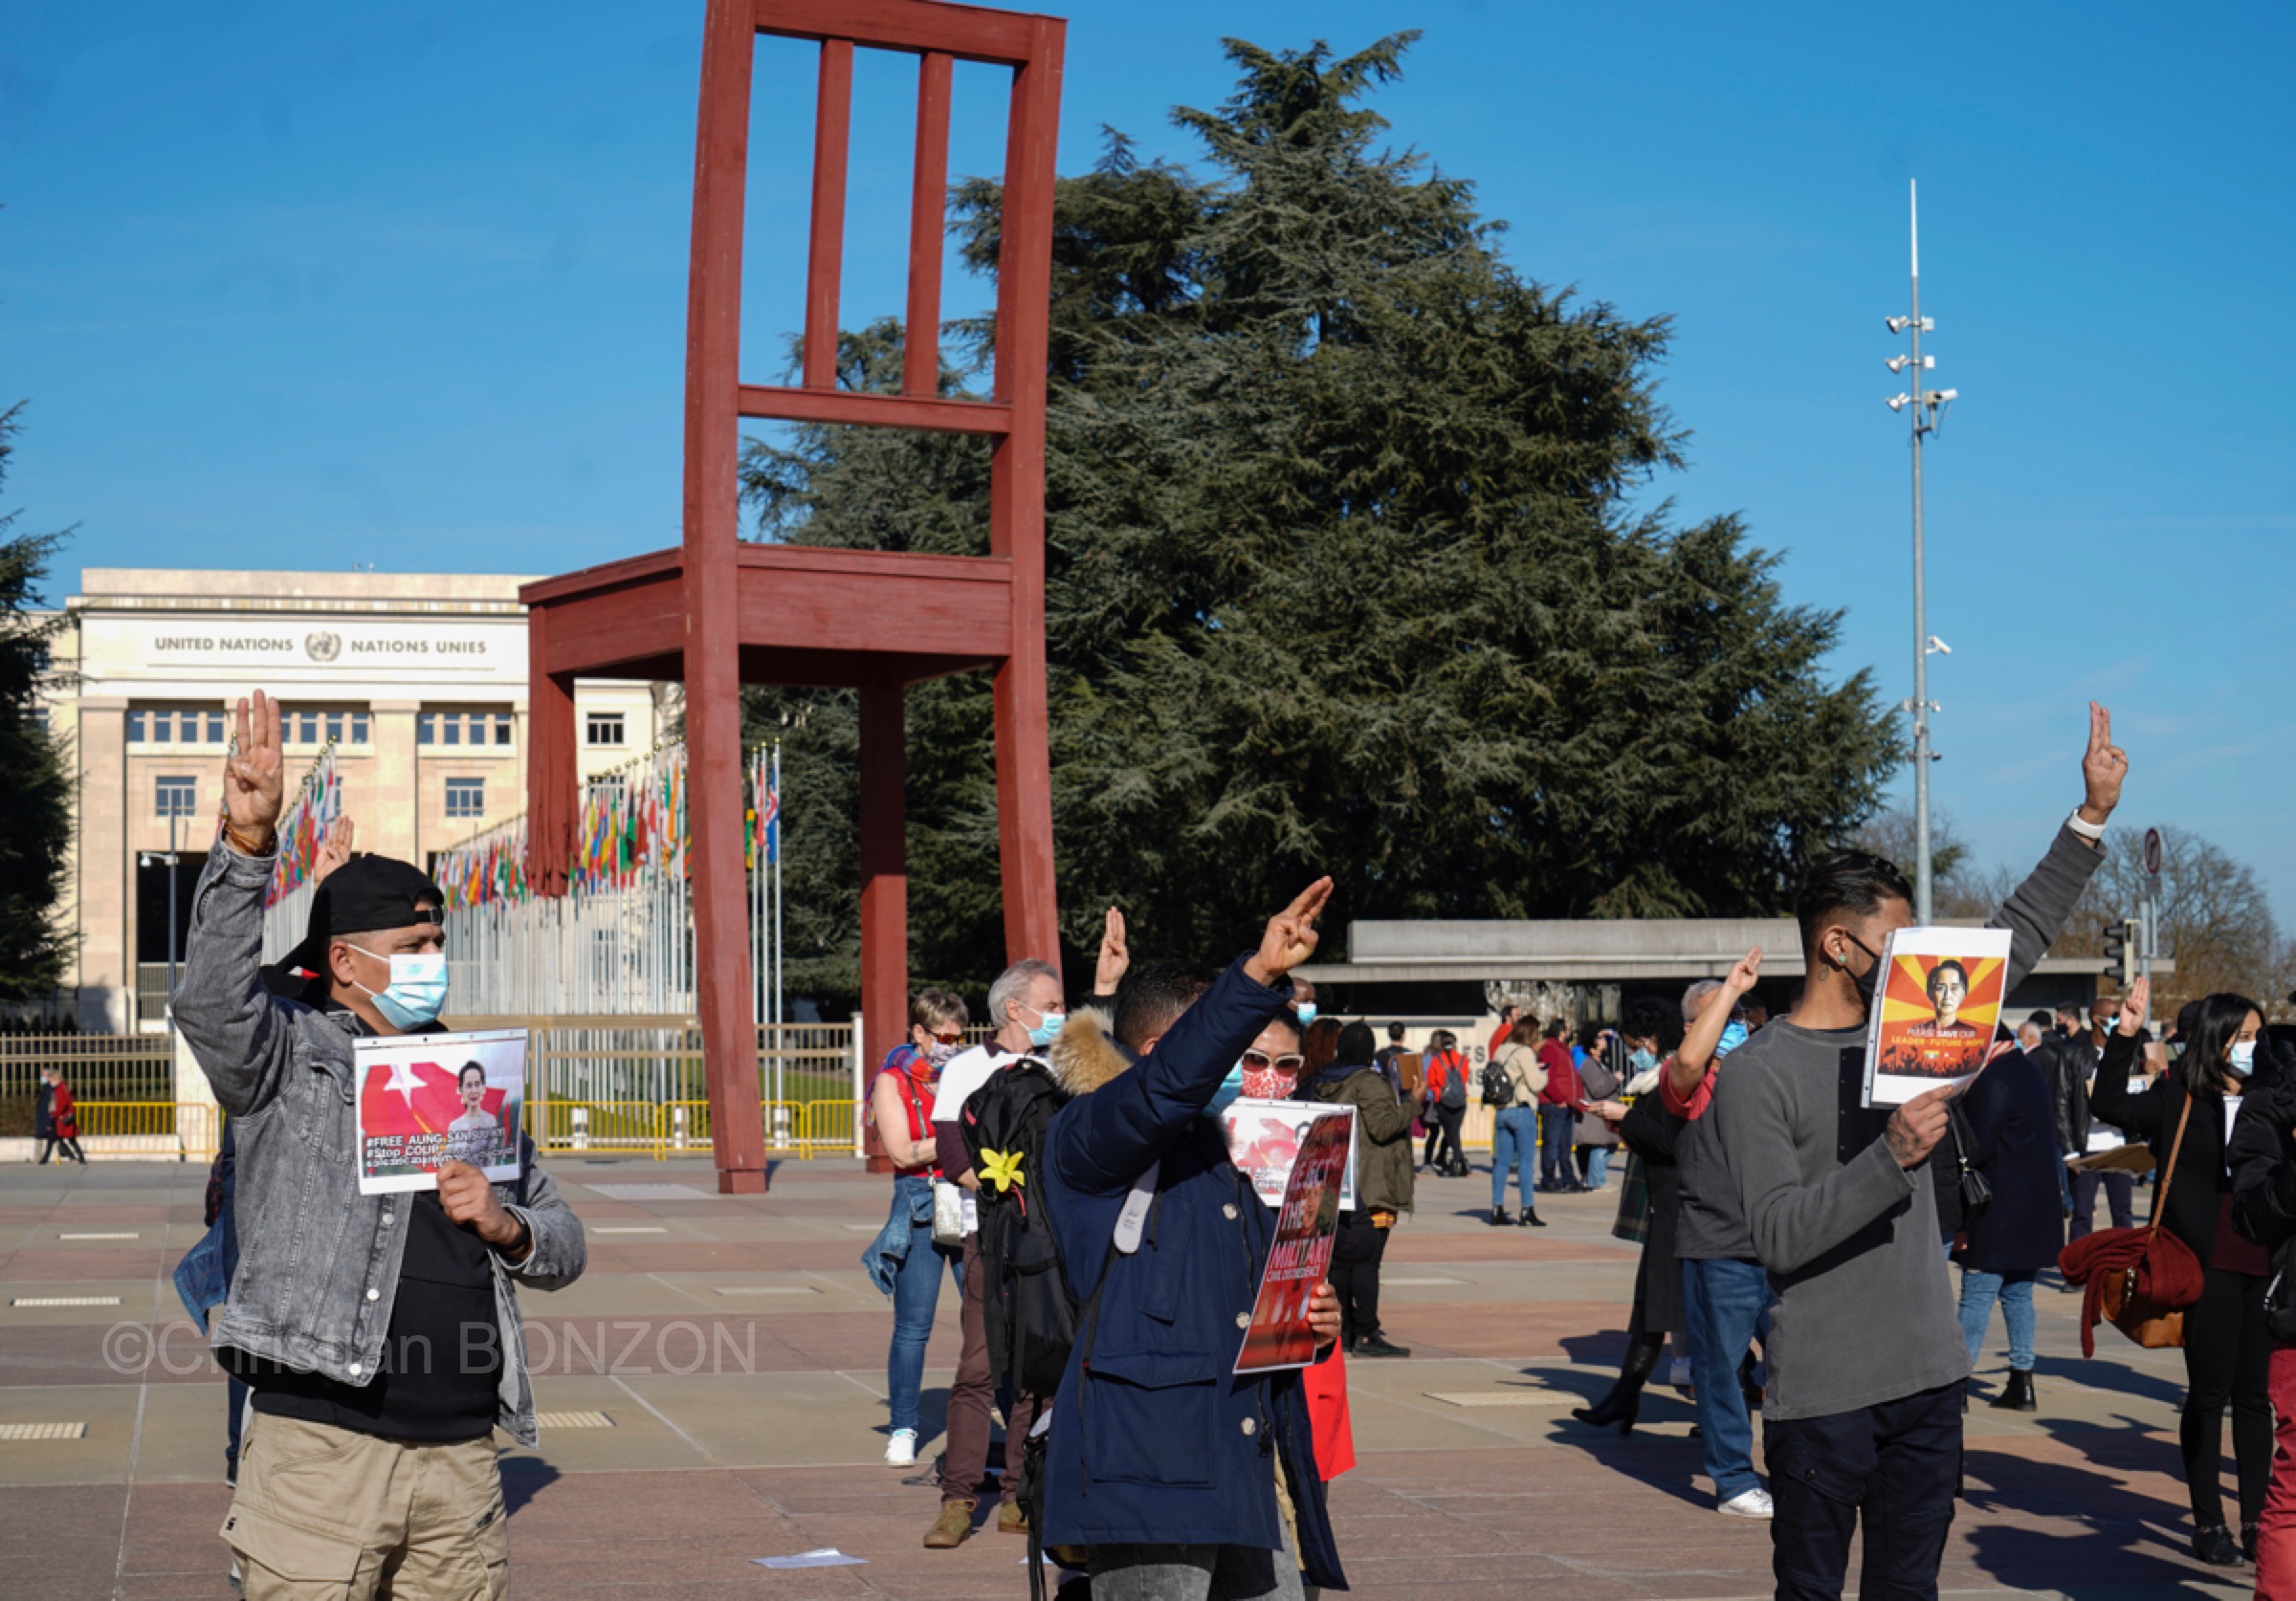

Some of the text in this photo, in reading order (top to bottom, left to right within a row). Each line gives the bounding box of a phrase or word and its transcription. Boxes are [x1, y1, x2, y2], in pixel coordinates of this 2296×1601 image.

[155, 637, 294, 651] UNITED NATIONS
[351, 640, 487, 653] NATIONS UNIES
